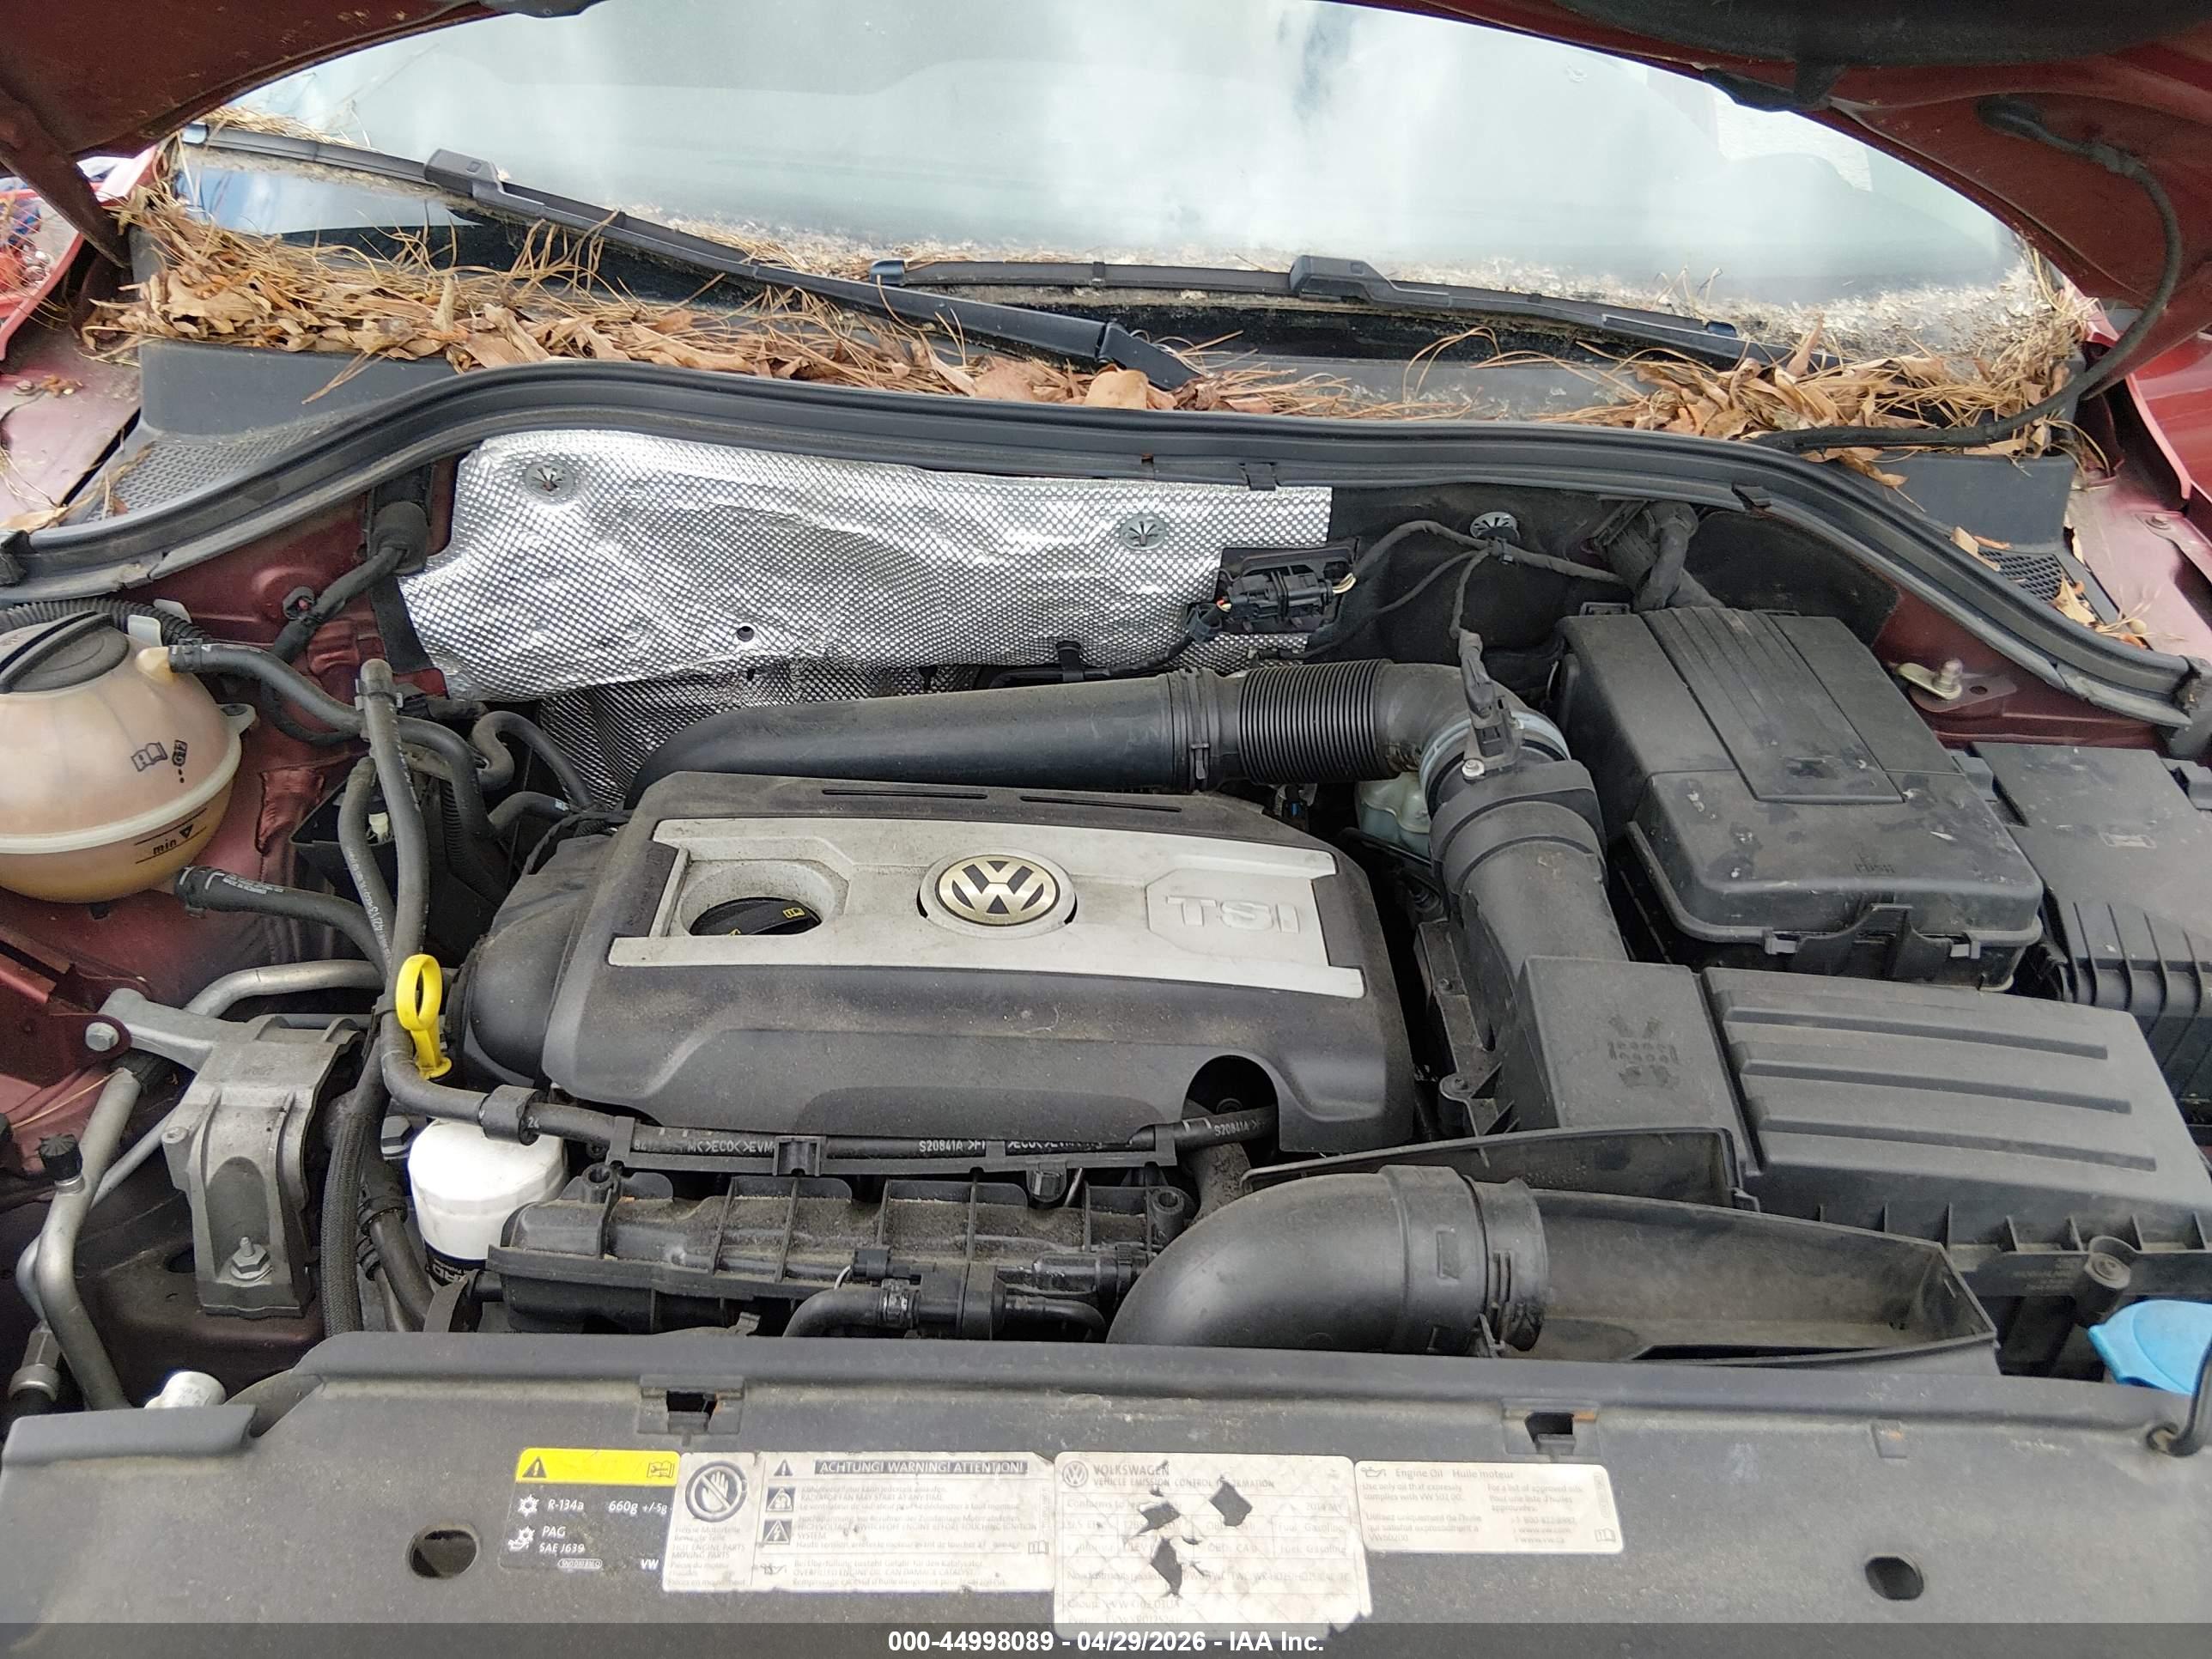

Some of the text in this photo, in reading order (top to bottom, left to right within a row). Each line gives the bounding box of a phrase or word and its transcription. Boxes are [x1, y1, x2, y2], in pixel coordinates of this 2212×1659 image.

[152, 839, 177, 855] min
[1165, 895, 1302, 933] TSI
[819, 1461, 1024, 1473] ACHTUNG! WARNING! ATTENTION!
[1092, 1464, 1170, 1476] VOLKSWAGEN
[1395, 1469, 1428, 1480] Engine
[1430, 1469, 1443, 1480] Oil
[1452, 1469, 1478, 1480] Huile
[547, 1499, 585, 1512] R-134a
[608, 1499, 639, 1512] 660g
[541, 1526, 567, 1538] PAG
[538, 1542, 586, 1553] SAE J639
[641, 1559, 659, 1570] VW
